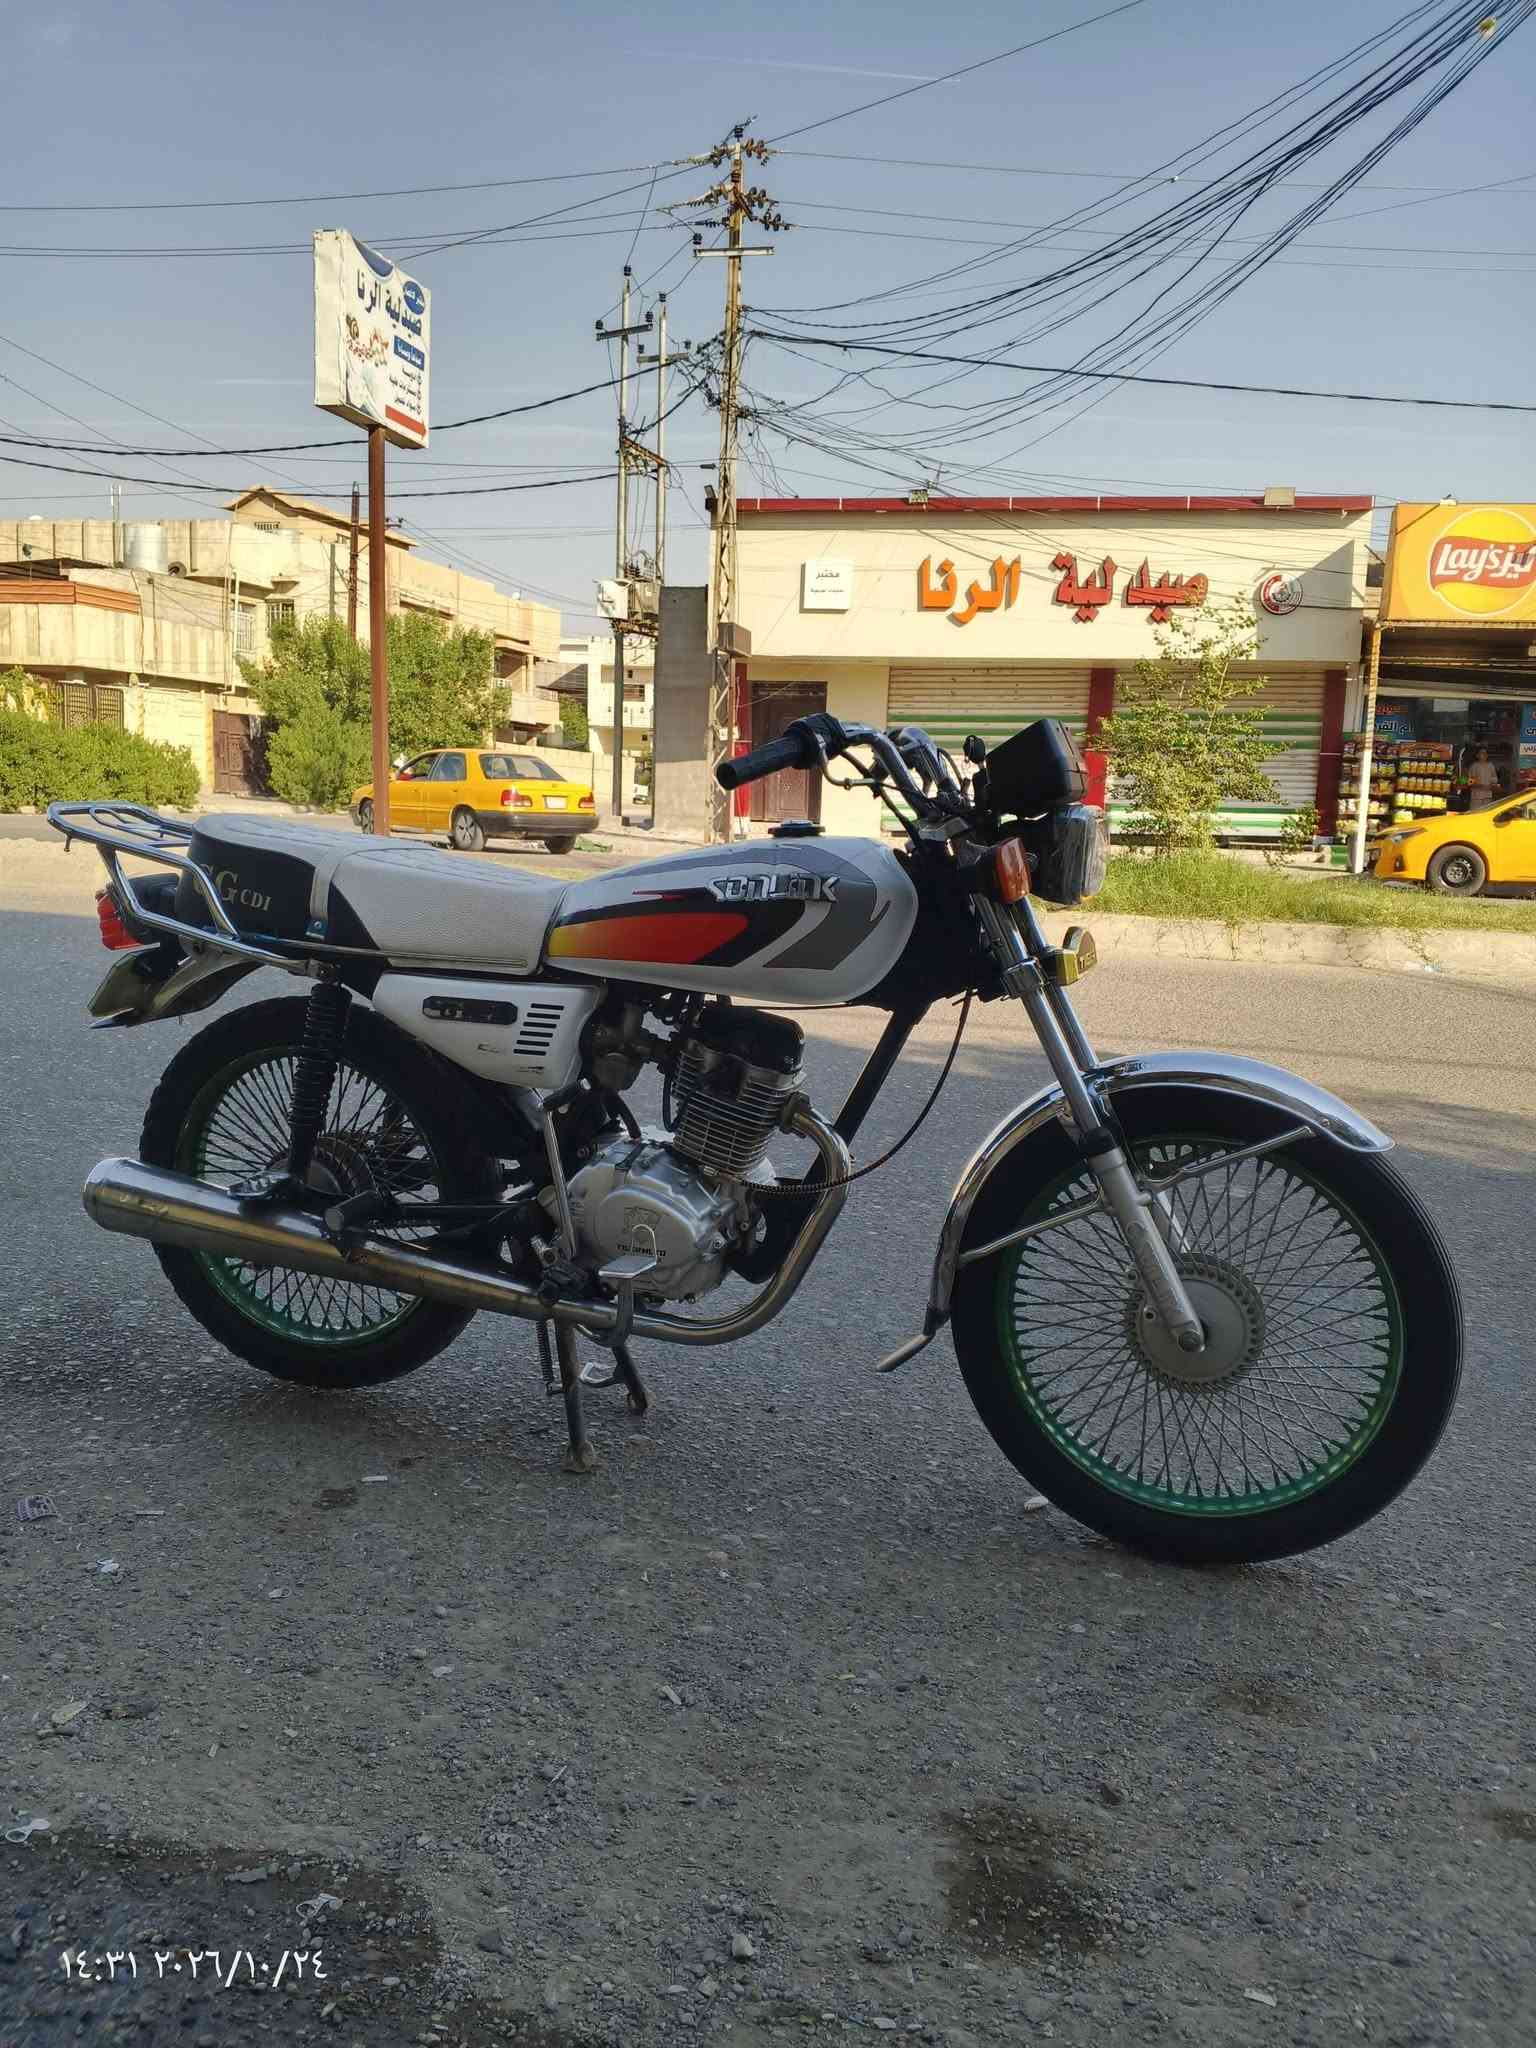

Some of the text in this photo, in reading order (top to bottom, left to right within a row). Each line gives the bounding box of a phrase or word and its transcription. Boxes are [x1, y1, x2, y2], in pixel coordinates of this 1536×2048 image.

[385, 289, 422, 338] صيدلية
[1436, 543, 1504, 581] Lay's
[918, 553, 1021, 627] الرنا
[1054, 552, 1209, 625] صيدلية
[240, 889, 272, 911] CDI
